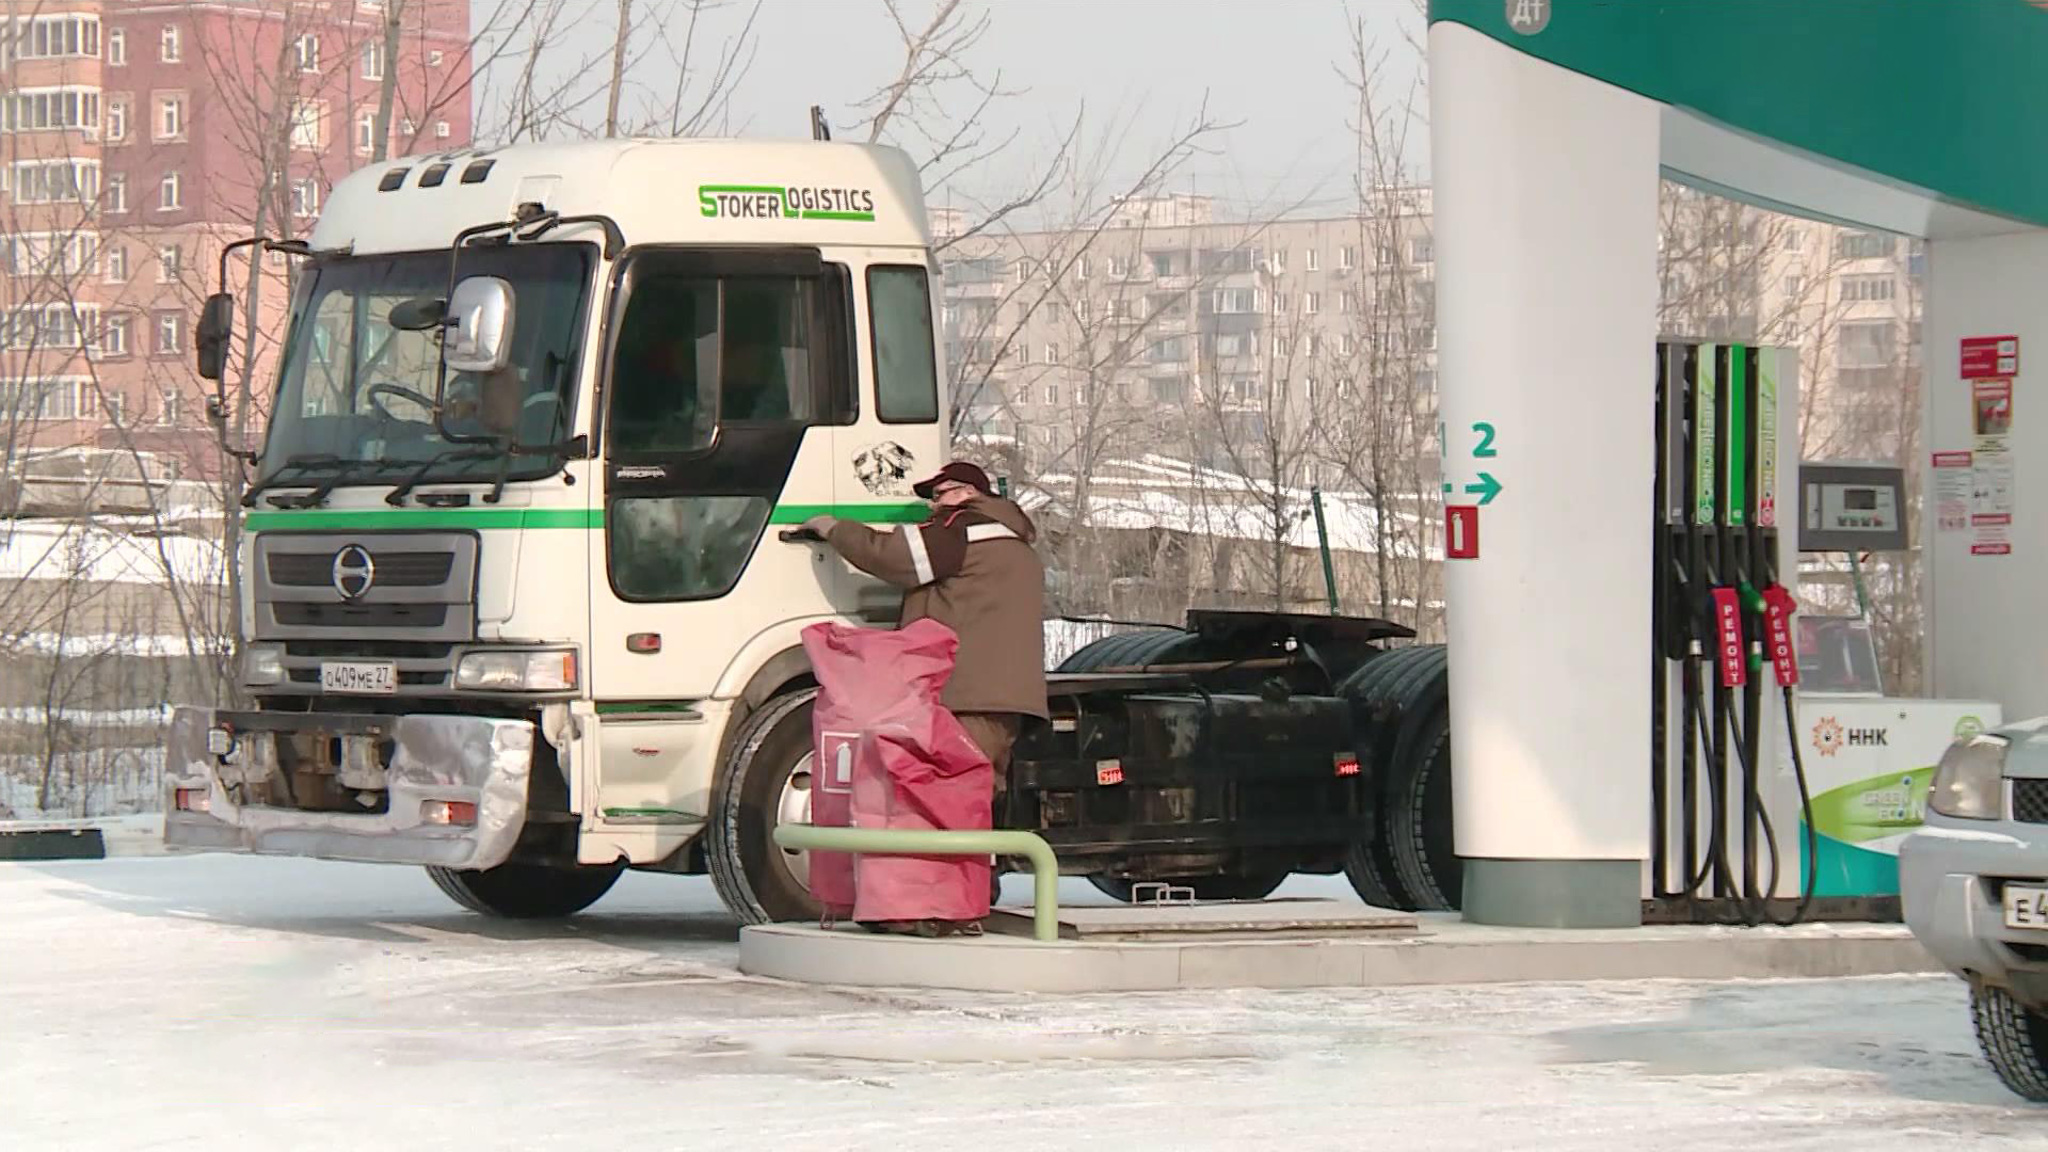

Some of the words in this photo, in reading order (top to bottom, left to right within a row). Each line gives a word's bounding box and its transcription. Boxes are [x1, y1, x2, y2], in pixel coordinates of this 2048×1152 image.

[698, 185, 780, 218] STOKER
[781, 186, 875, 220] LOGISTICS
[1471, 422, 1497, 458] 2
[1723, 604, 1740, 683] РЕМОНТ
[1770, 605, 1792, 684] РЕМОНТ
[1849, 728, 1888, 746] ННК
